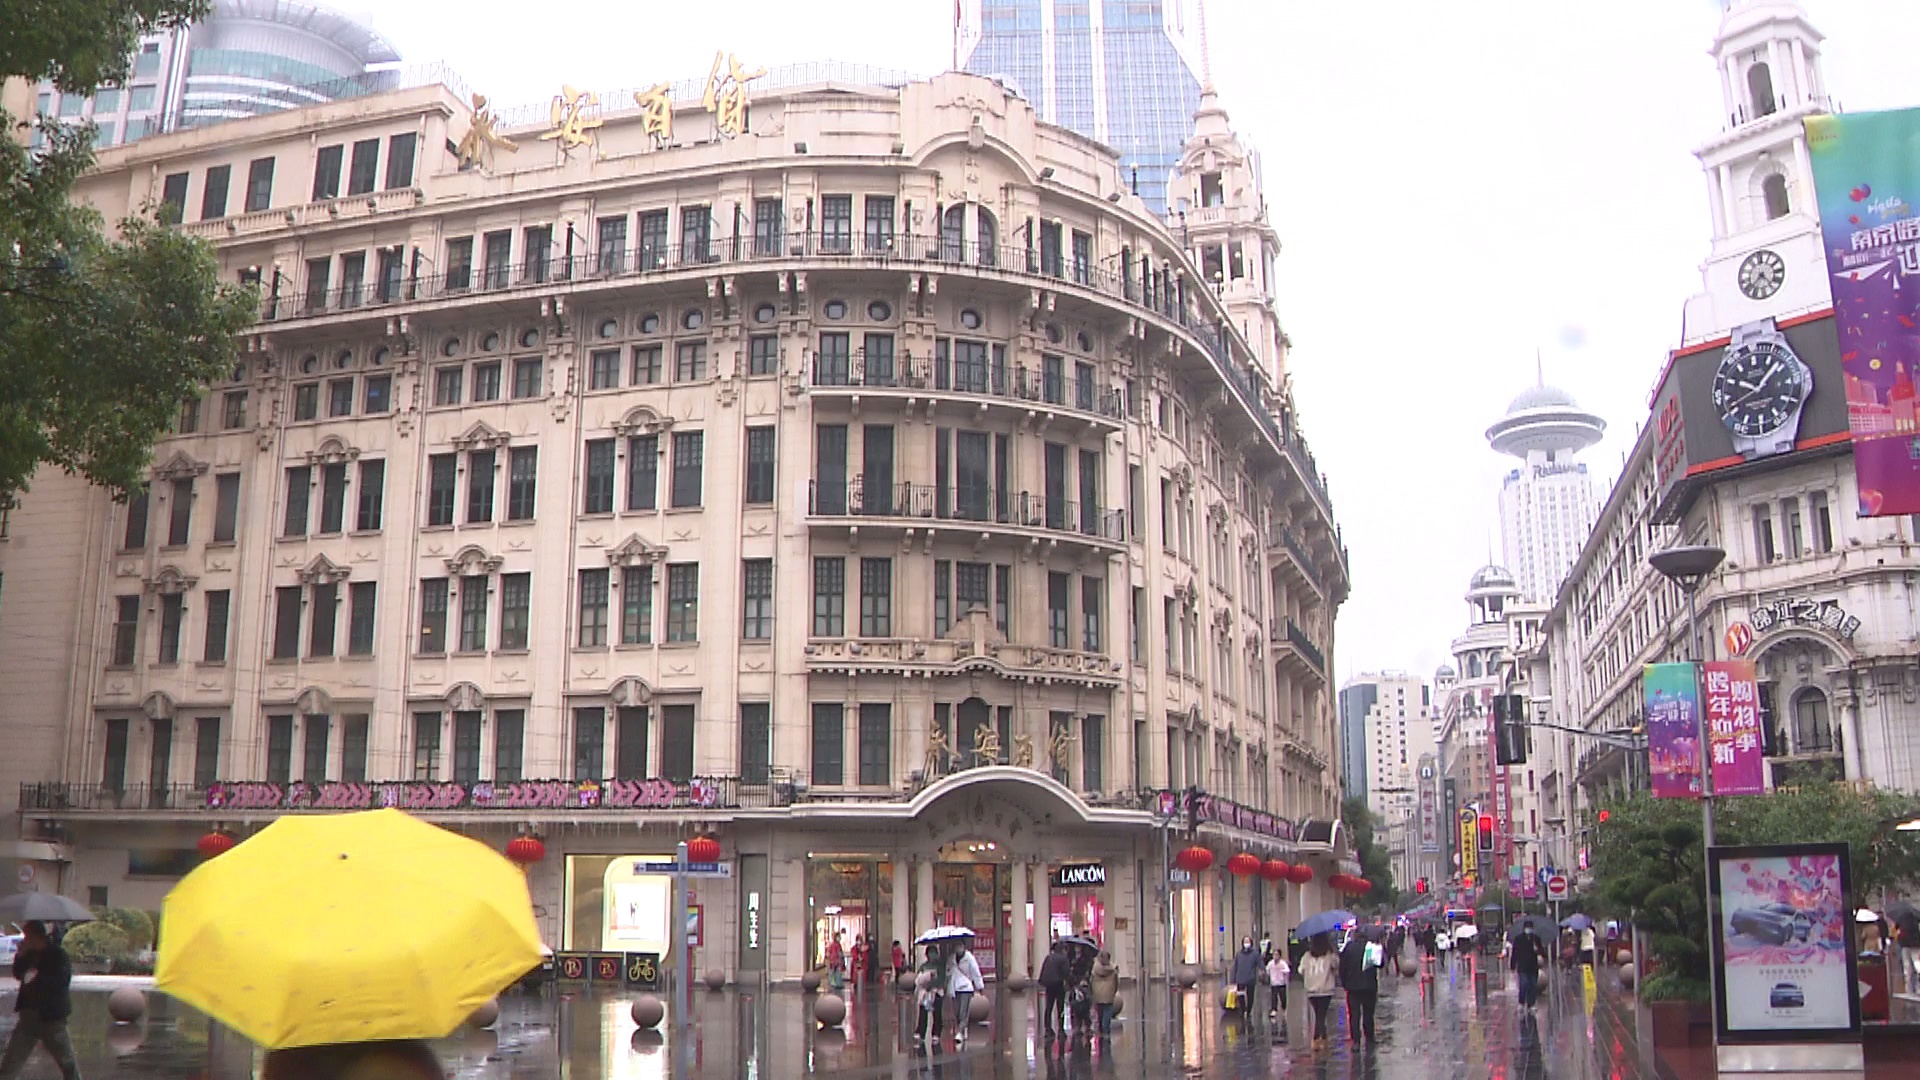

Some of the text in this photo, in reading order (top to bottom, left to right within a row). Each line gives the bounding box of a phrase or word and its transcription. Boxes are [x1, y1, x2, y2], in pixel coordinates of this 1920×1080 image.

[1707, 671, 1735, 764] 跨年迎新
[1730, 680, 1757, 752] 购物季
